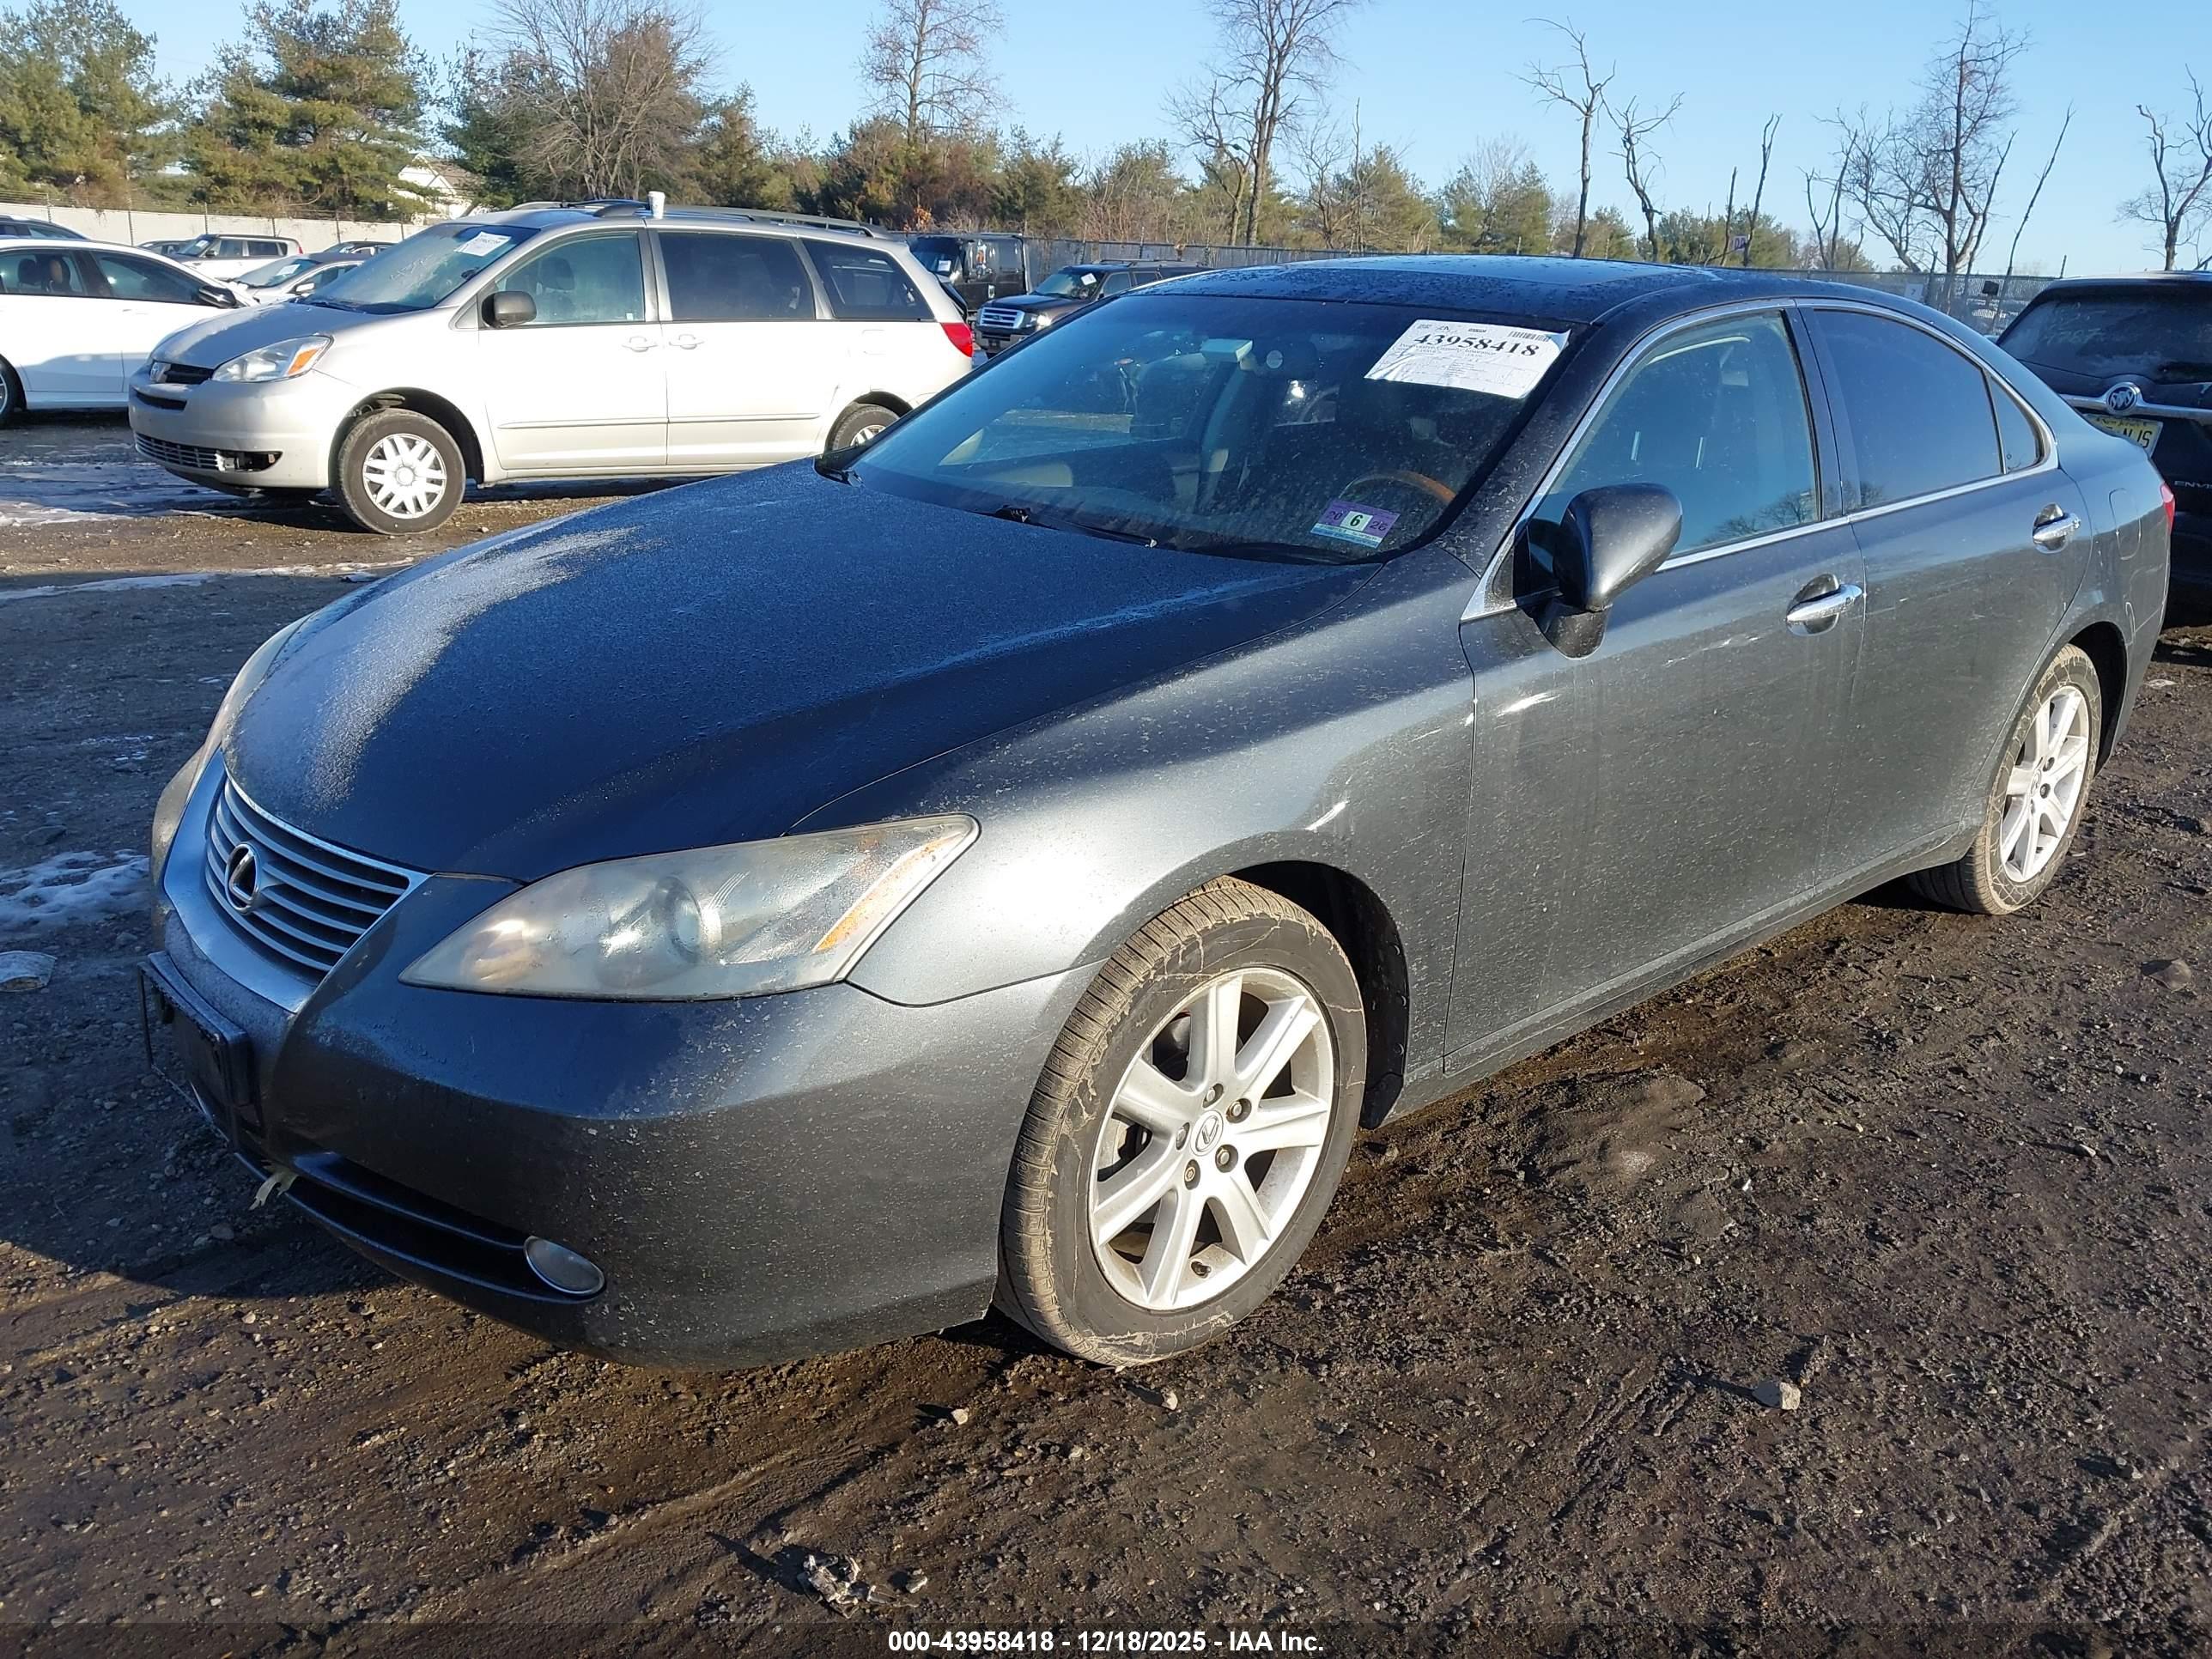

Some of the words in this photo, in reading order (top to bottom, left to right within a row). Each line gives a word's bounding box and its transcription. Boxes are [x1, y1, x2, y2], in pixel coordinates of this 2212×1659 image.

[1413, 333, 1540, 356] 43958418
[2174, 480, 2212, 489] ENVI
[1350, 514, 1364, 526] 6
[1370, 520, 1389, 532] 26
